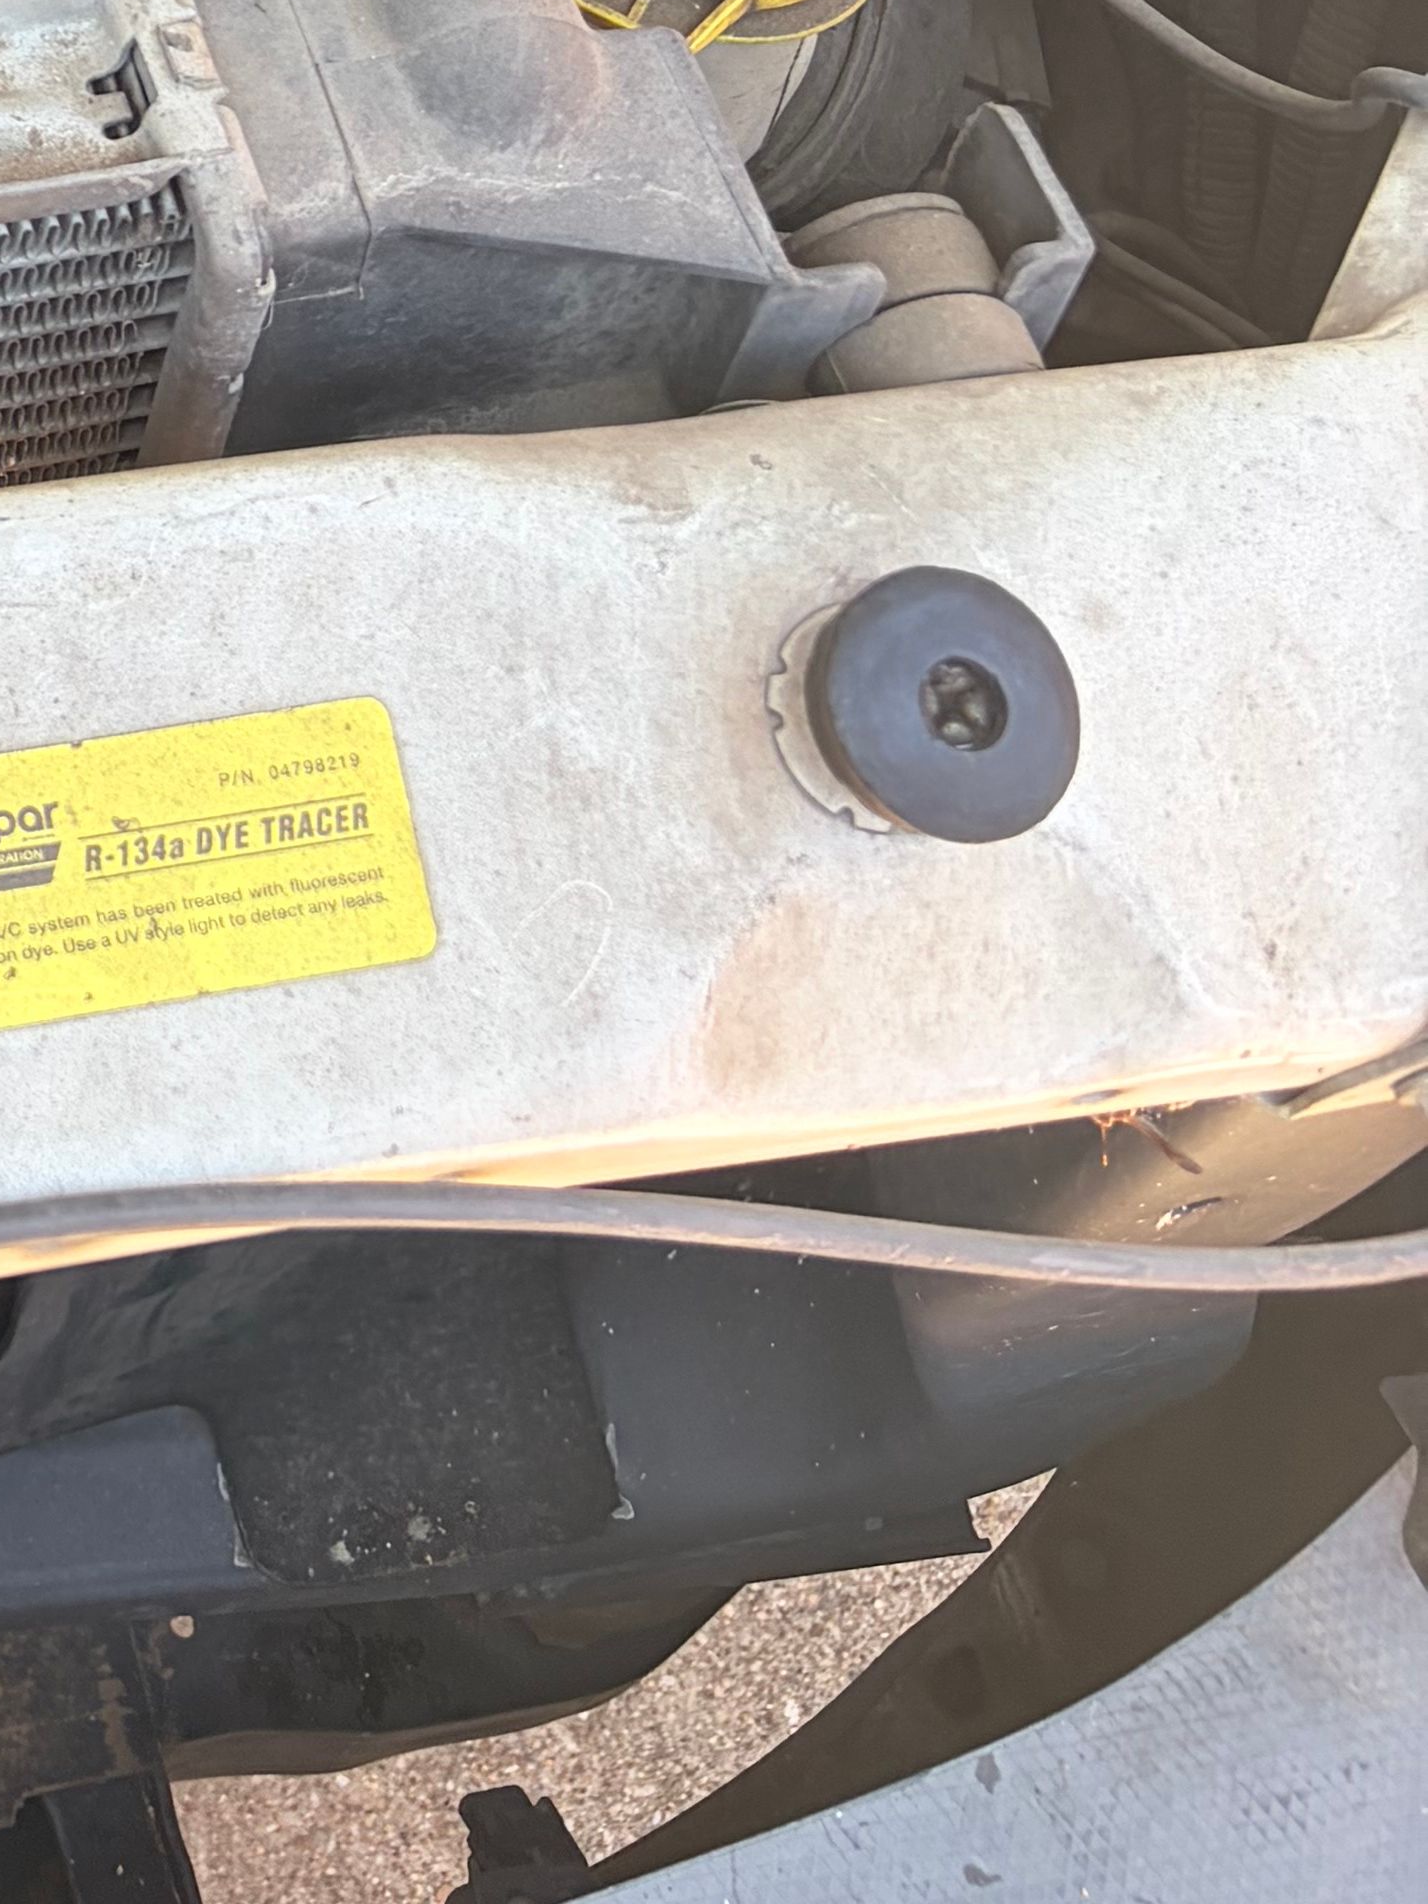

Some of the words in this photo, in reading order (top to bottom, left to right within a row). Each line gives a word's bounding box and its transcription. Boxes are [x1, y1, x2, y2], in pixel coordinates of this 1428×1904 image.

[268, 752, 360, 780] 04798219
[84, 834, 184, 872] R-134a
[196, 820, 249, 855] DYE
[260, 802, 368, 843] TRACER
[27, 914, 91, 936] system
[95, 908, 128, 925] has
[132, 900, 176, 922] been
[181, 887, 243, 910] treated
[248, 881, 288, 899] with
[289, 866, 384, 893] fluorescent
